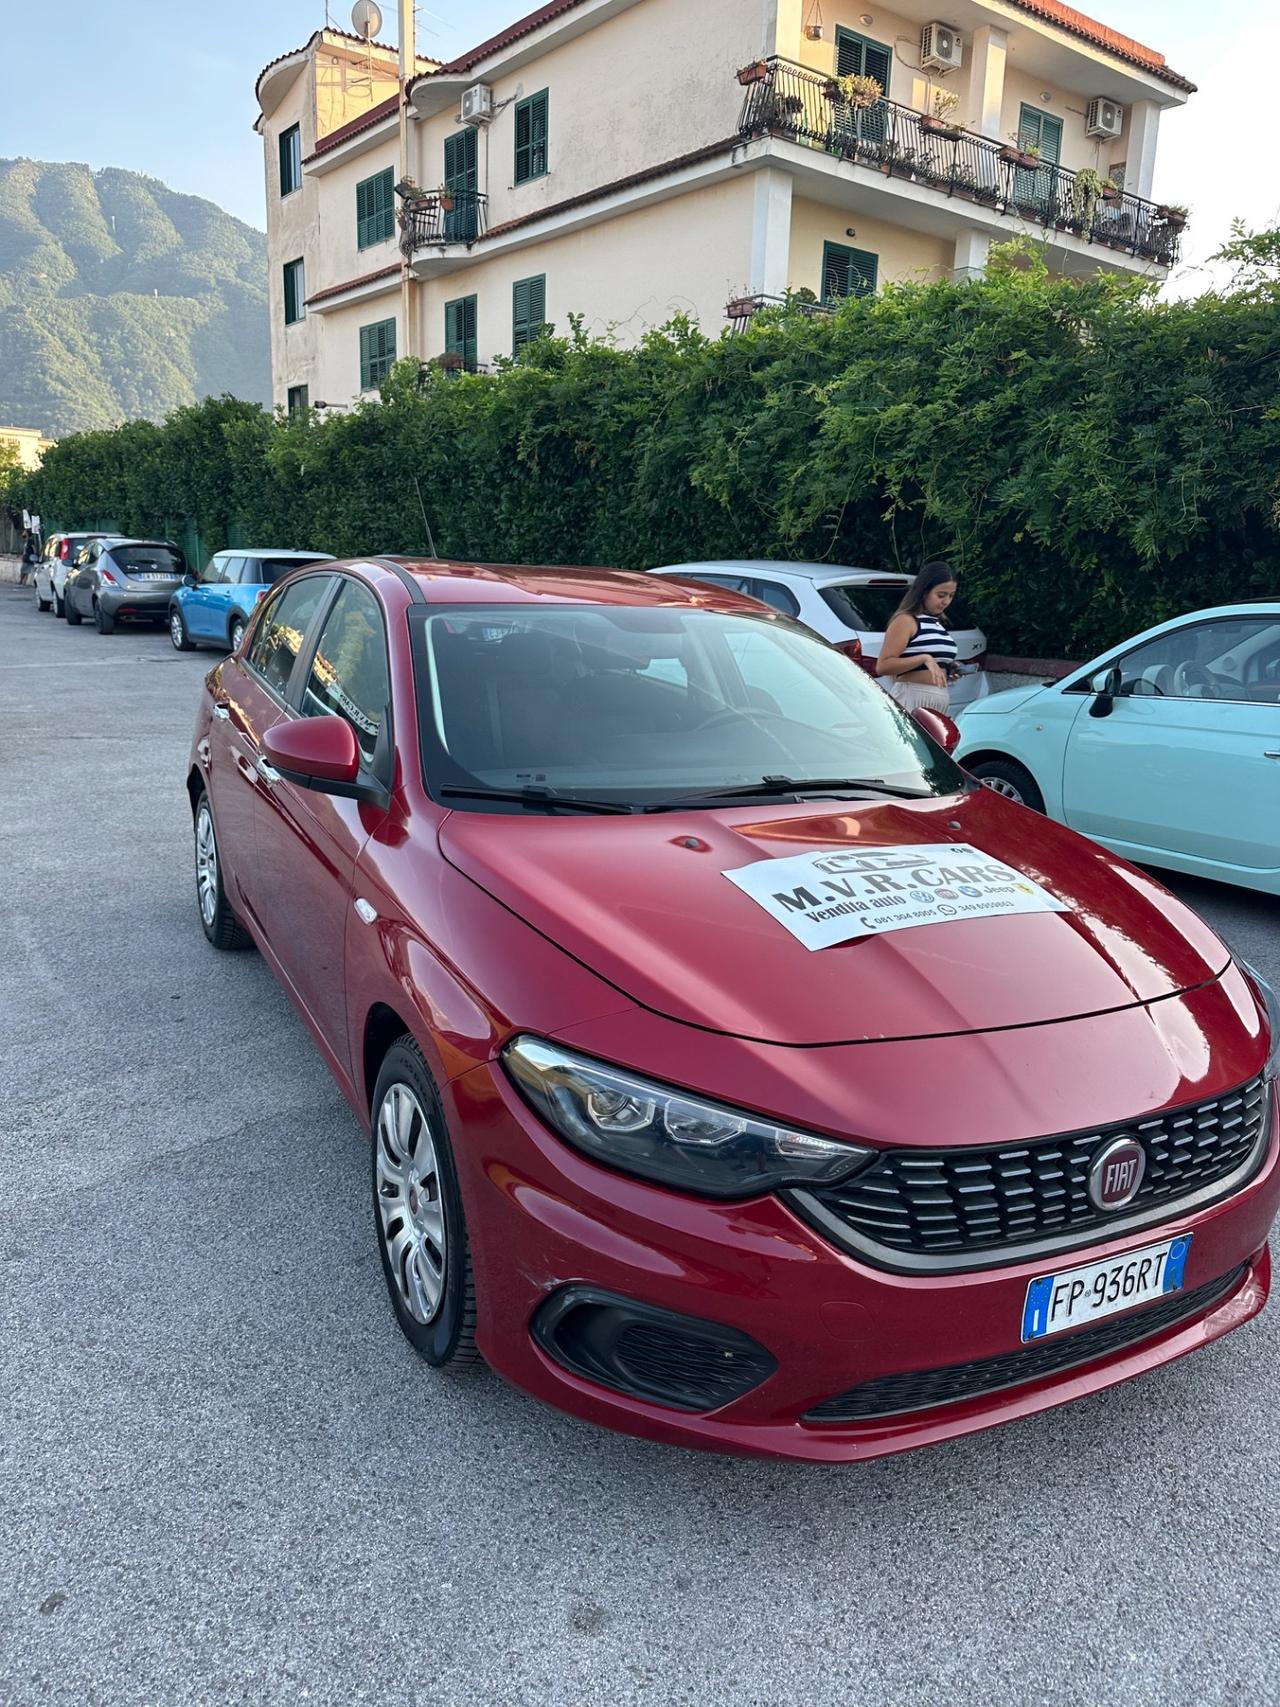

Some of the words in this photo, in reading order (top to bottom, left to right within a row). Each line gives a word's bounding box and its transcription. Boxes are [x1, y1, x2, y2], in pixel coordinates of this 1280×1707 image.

[983, 885, 1016, 894] Jeep
[805, 900, 871, 923] Vendita
[869, 895, 907, 908] auto
[874, 915, 894, 924] 081
[1103, 1158, 1137, 1195] FIAT
